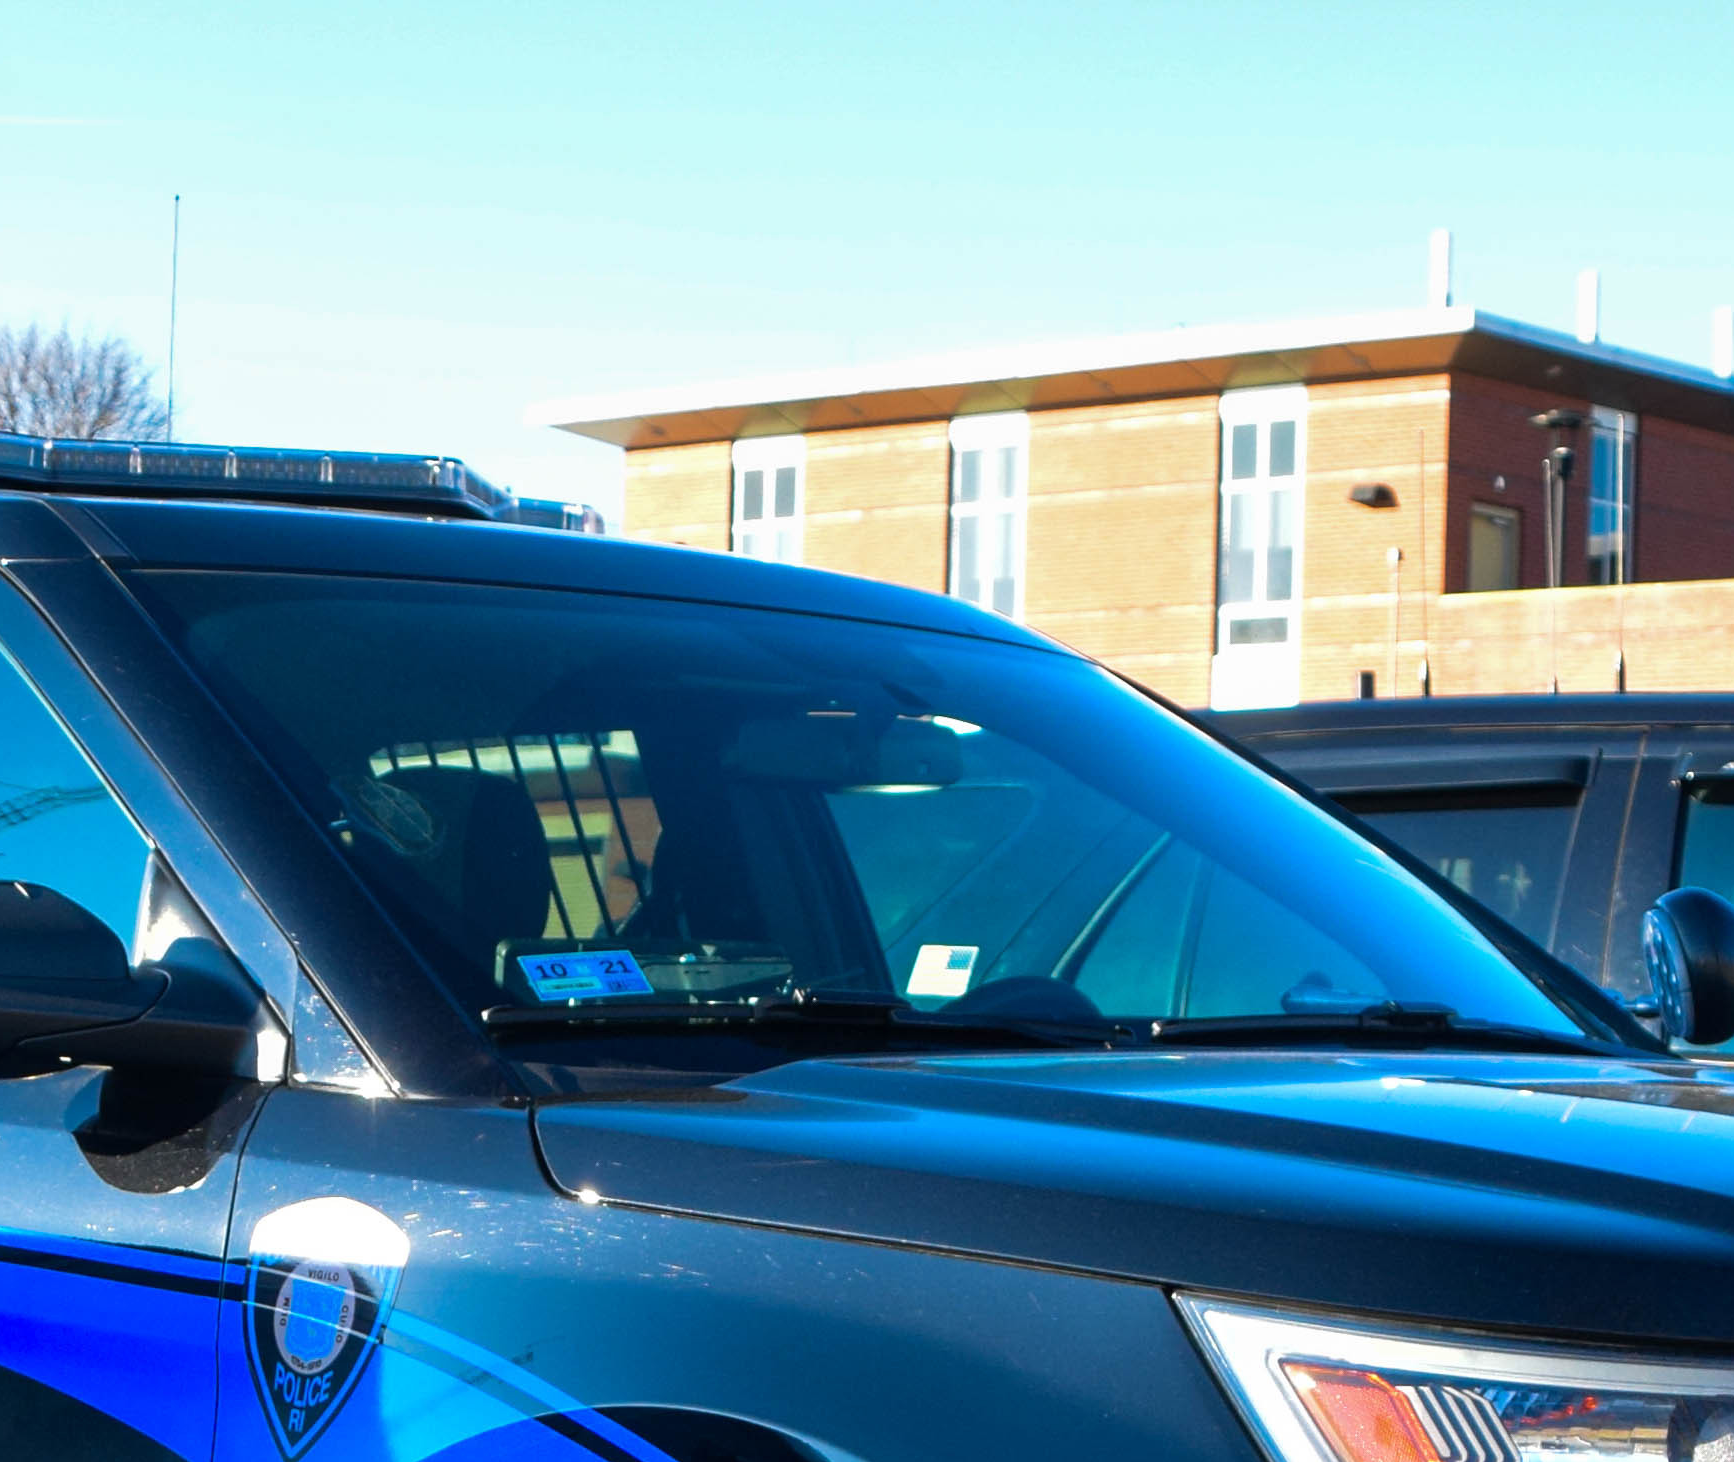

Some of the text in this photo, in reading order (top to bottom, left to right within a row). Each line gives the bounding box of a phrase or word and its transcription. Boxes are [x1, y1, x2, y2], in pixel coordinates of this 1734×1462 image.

[535, 959, 634, 979] 10 21
[307, 1268, 340, 1283] VIGILO
[274, 1361, 334, 1408] POLICE
[288, 1408, 307, 1433] RI
